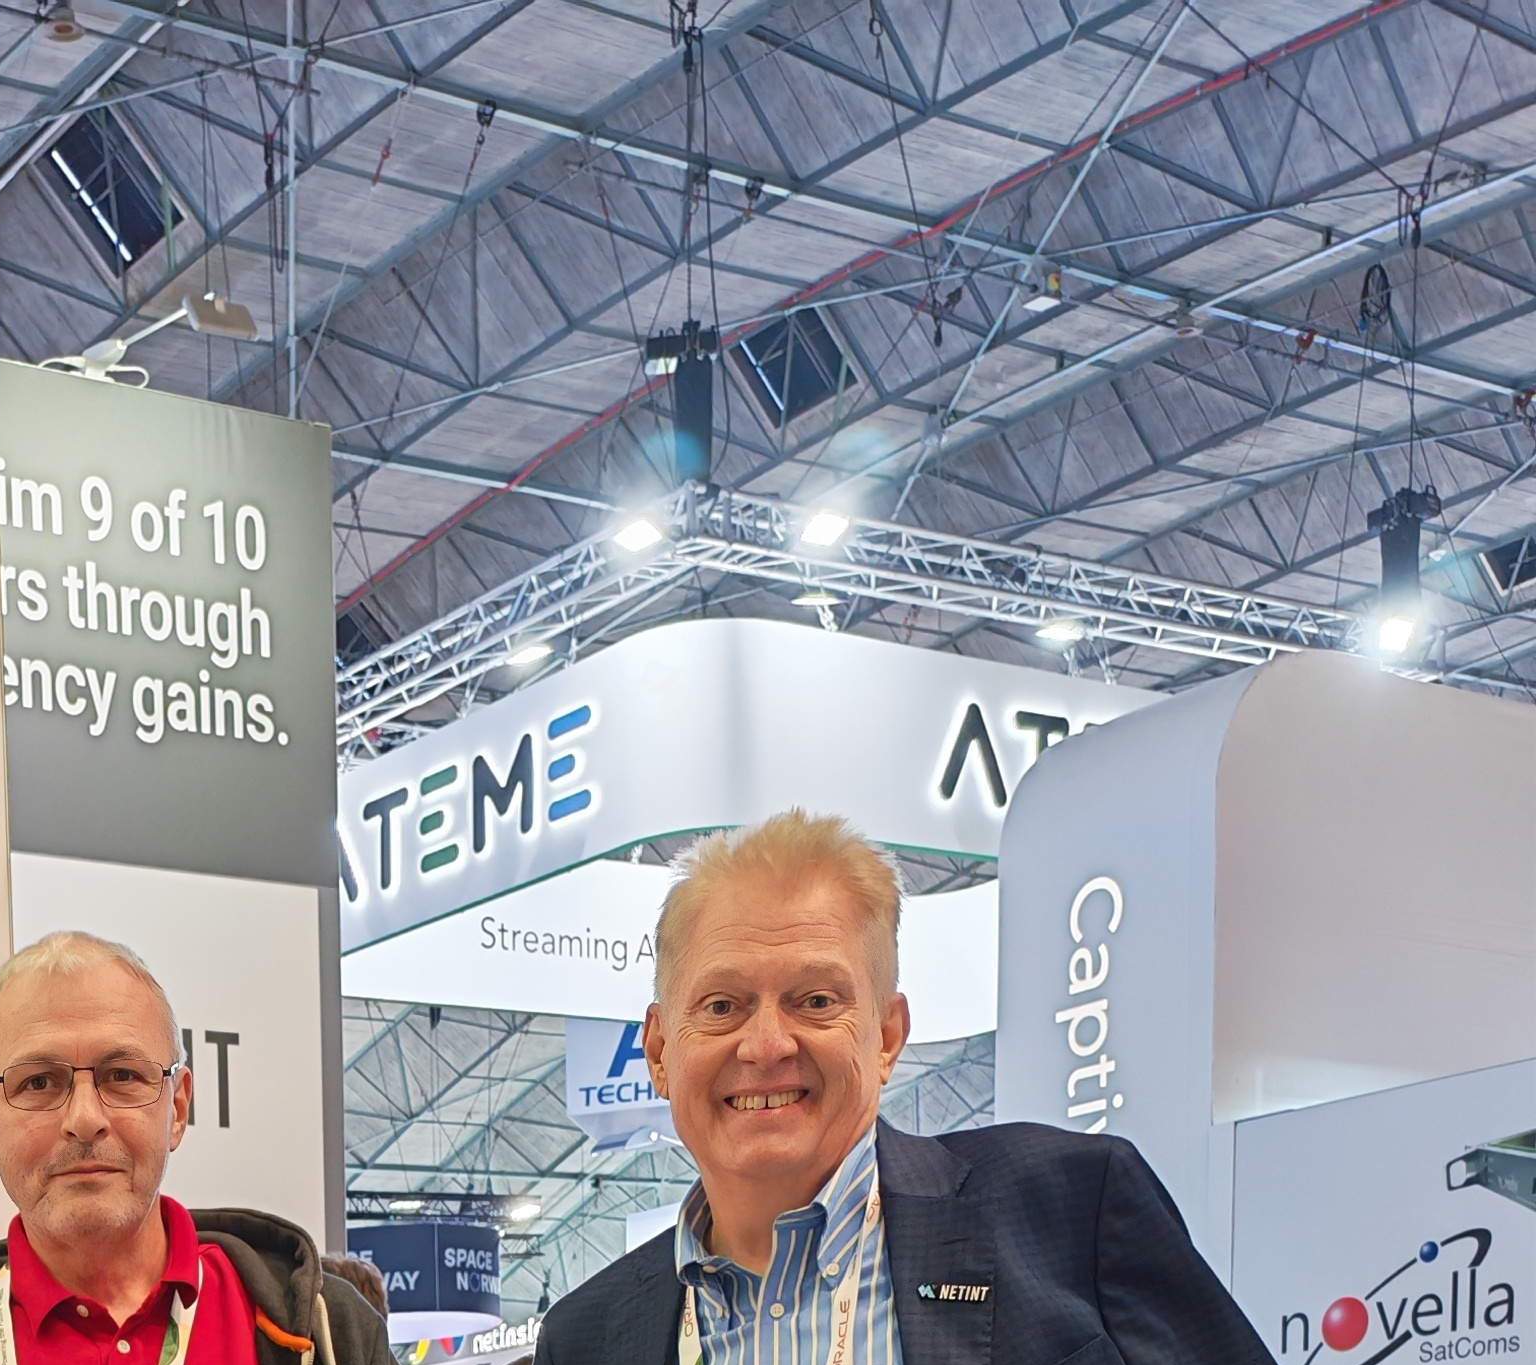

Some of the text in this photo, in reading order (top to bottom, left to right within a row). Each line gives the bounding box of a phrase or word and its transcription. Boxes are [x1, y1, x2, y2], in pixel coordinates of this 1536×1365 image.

[80, 475, 112, 541] 9
[130, 488, 187, 556] of
[203, 500, 266, 571] 10
[62, 560, 271, 669] through
[132, 668, 289, 746] gains.
[338, 705, 591, 902] TEME
[480, 916, 628, 971] Streaming
[579, 1081, 659, 1107] TECH
[384, 1271, 420, 1291] AY
[444, 1248, 493, 1271] SPACE
[939, 1284, 990, 1302] NETINT
[1281, 1267, 1515, 1355] novella
[1419, 1335, 1521, 1364] SatComs
